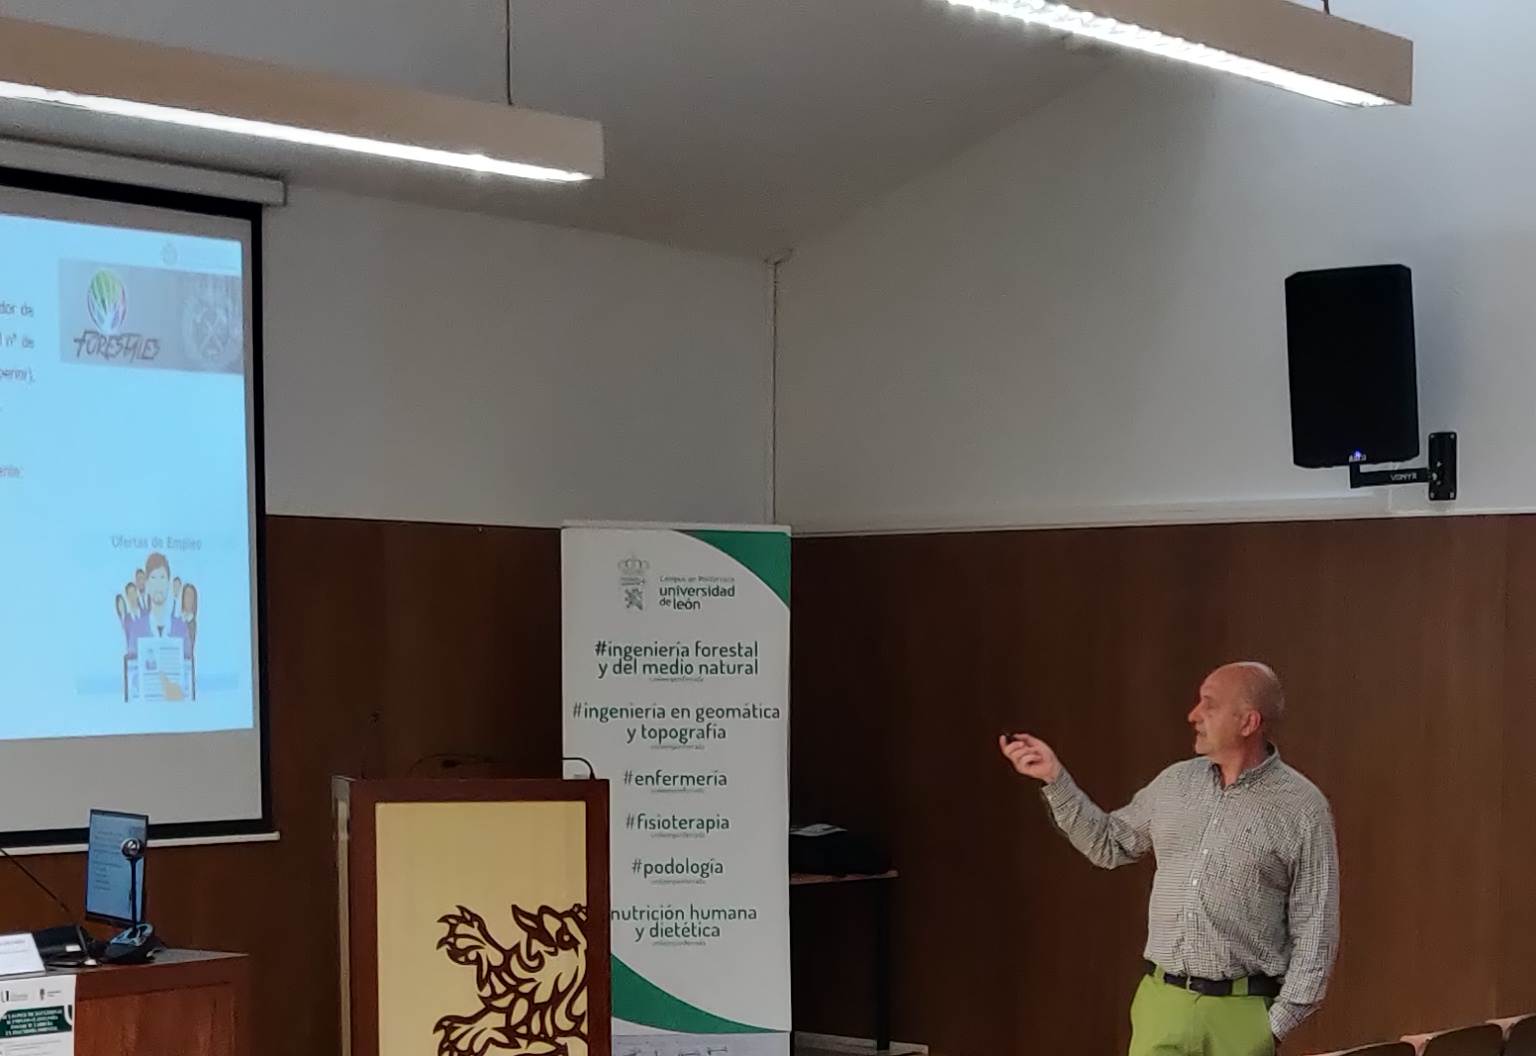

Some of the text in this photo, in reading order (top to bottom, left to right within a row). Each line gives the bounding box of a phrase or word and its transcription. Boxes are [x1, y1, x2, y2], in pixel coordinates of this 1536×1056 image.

[20, 303, 34, 318] de
[22, 335, 35, 349] de
[111, 535, 202, 551] Ofertas de Empleo
[659, 584, 735, 597] universidad
[659, 597, 701, 610] de león
[595, 641, 758, 661] #ingeniería forestal
[598, 658, 758, 679] y del medio natural
[573, 702, 780, 723] #ingeniería en geomática
[627, 723, 726, 744] y topografía
[623, 769, 728, 787] #enfermería
[626, 813, 730, 834] #fisioterapia
[631, 857, 724, 878] #podología
[690, 903, 757, 920] humana
[635, 922, 721, 942] y dietética
